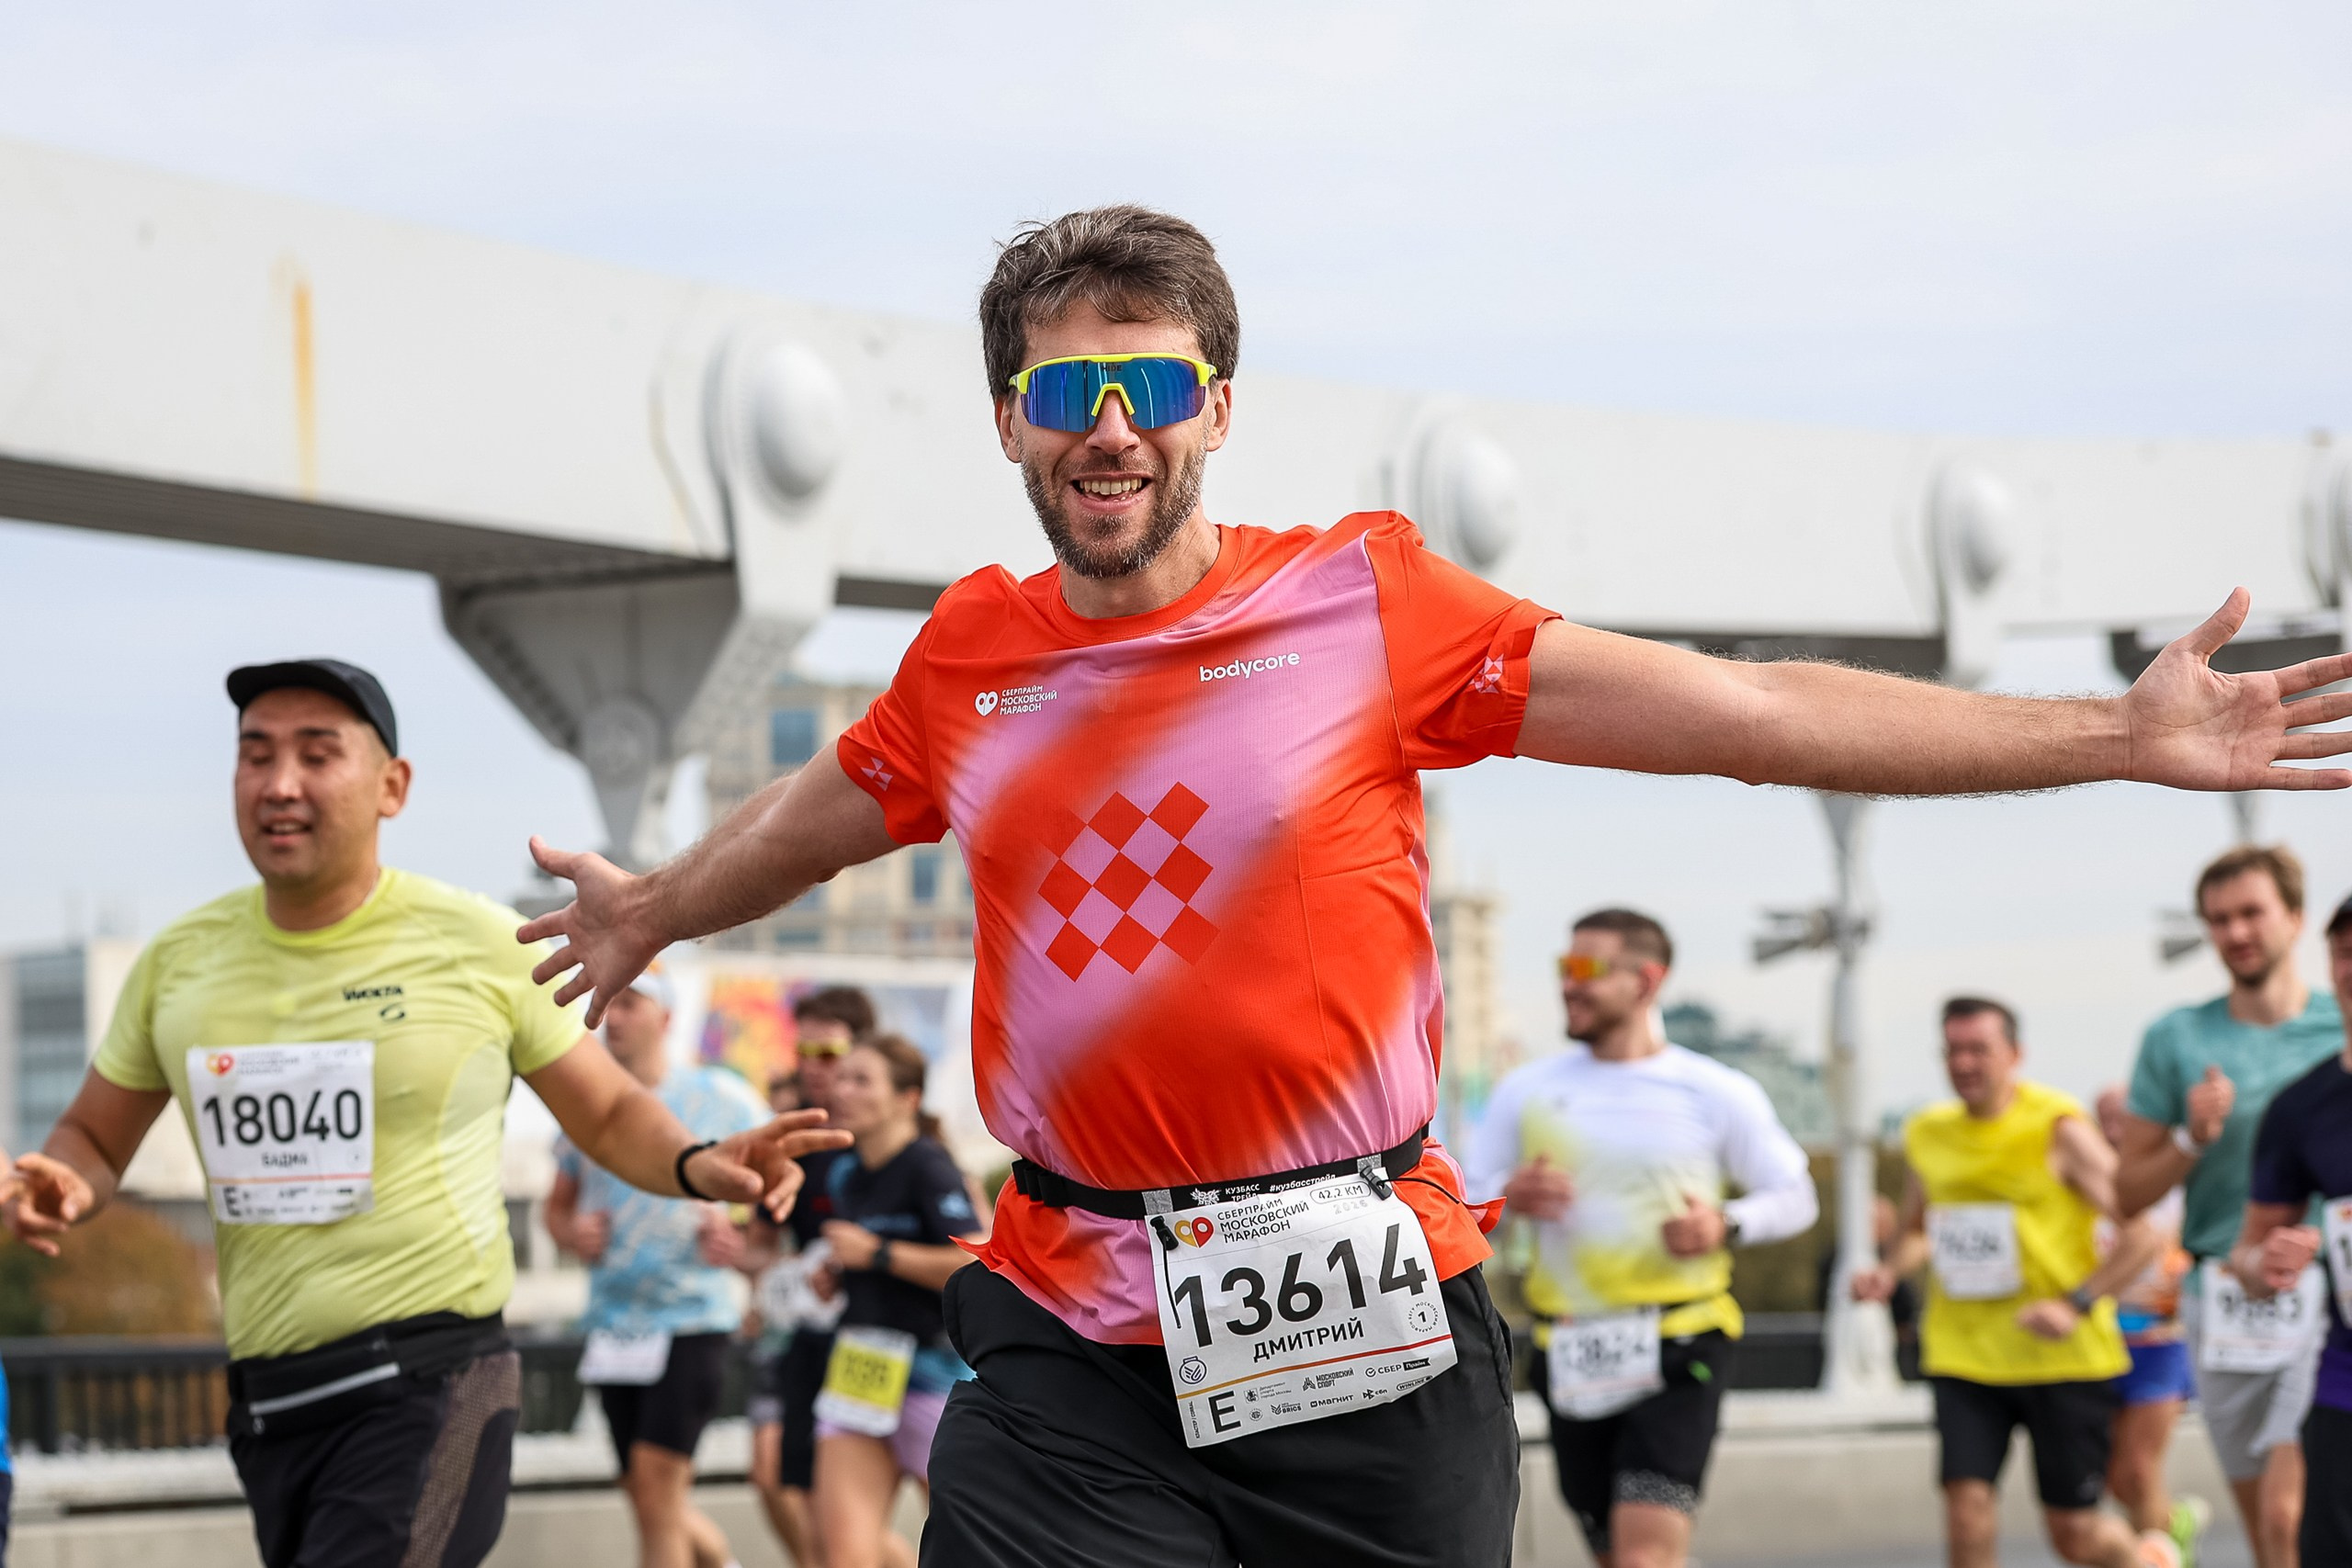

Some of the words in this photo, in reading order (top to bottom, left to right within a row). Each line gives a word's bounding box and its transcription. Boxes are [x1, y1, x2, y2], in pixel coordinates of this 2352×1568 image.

[1102, 364, 1123, 372] HIDE
[1199, 652, 1301, 682] bodycore
[1001, 684, 1044, 697] СБЕРПРАЙМ
[1001, 690, 1058, 706] МОСКОВСКИЙ
[1000, 703, 1042, 716] МАРАФОН
[202, 1089, 362, 1147] 18040
[1225, 1183, 1261, 1195] КУЗБАСС
[1318, 1188, 1343, 1200] 42,2
[1345, 1185, 1363, 1196] КМ
[1217, 1198, 1283, 1221] СБЕРПРАЙМ
[1220, 1201, 1310, 1233] МОСКОВСКИЙ
[1224, 1219, 1292, 1244] МАРАФОН
[1174, 1224, 1428, 1348] 13614
[1418, 1311, 1427, 1323] 1
[1252, 1317, 1365, 1364] ДМИТРИЙ
[1316, 1367, 1355, 1382] МОСКОВСКИЙ
[1377, 1364, 1402, 1374] СБЕР
[1317, 1378, 1336, 1389] СПОРТ
[1208, 1390, 1242, 1434] E
[1282, 1405, 1302, 1414] BRICS
